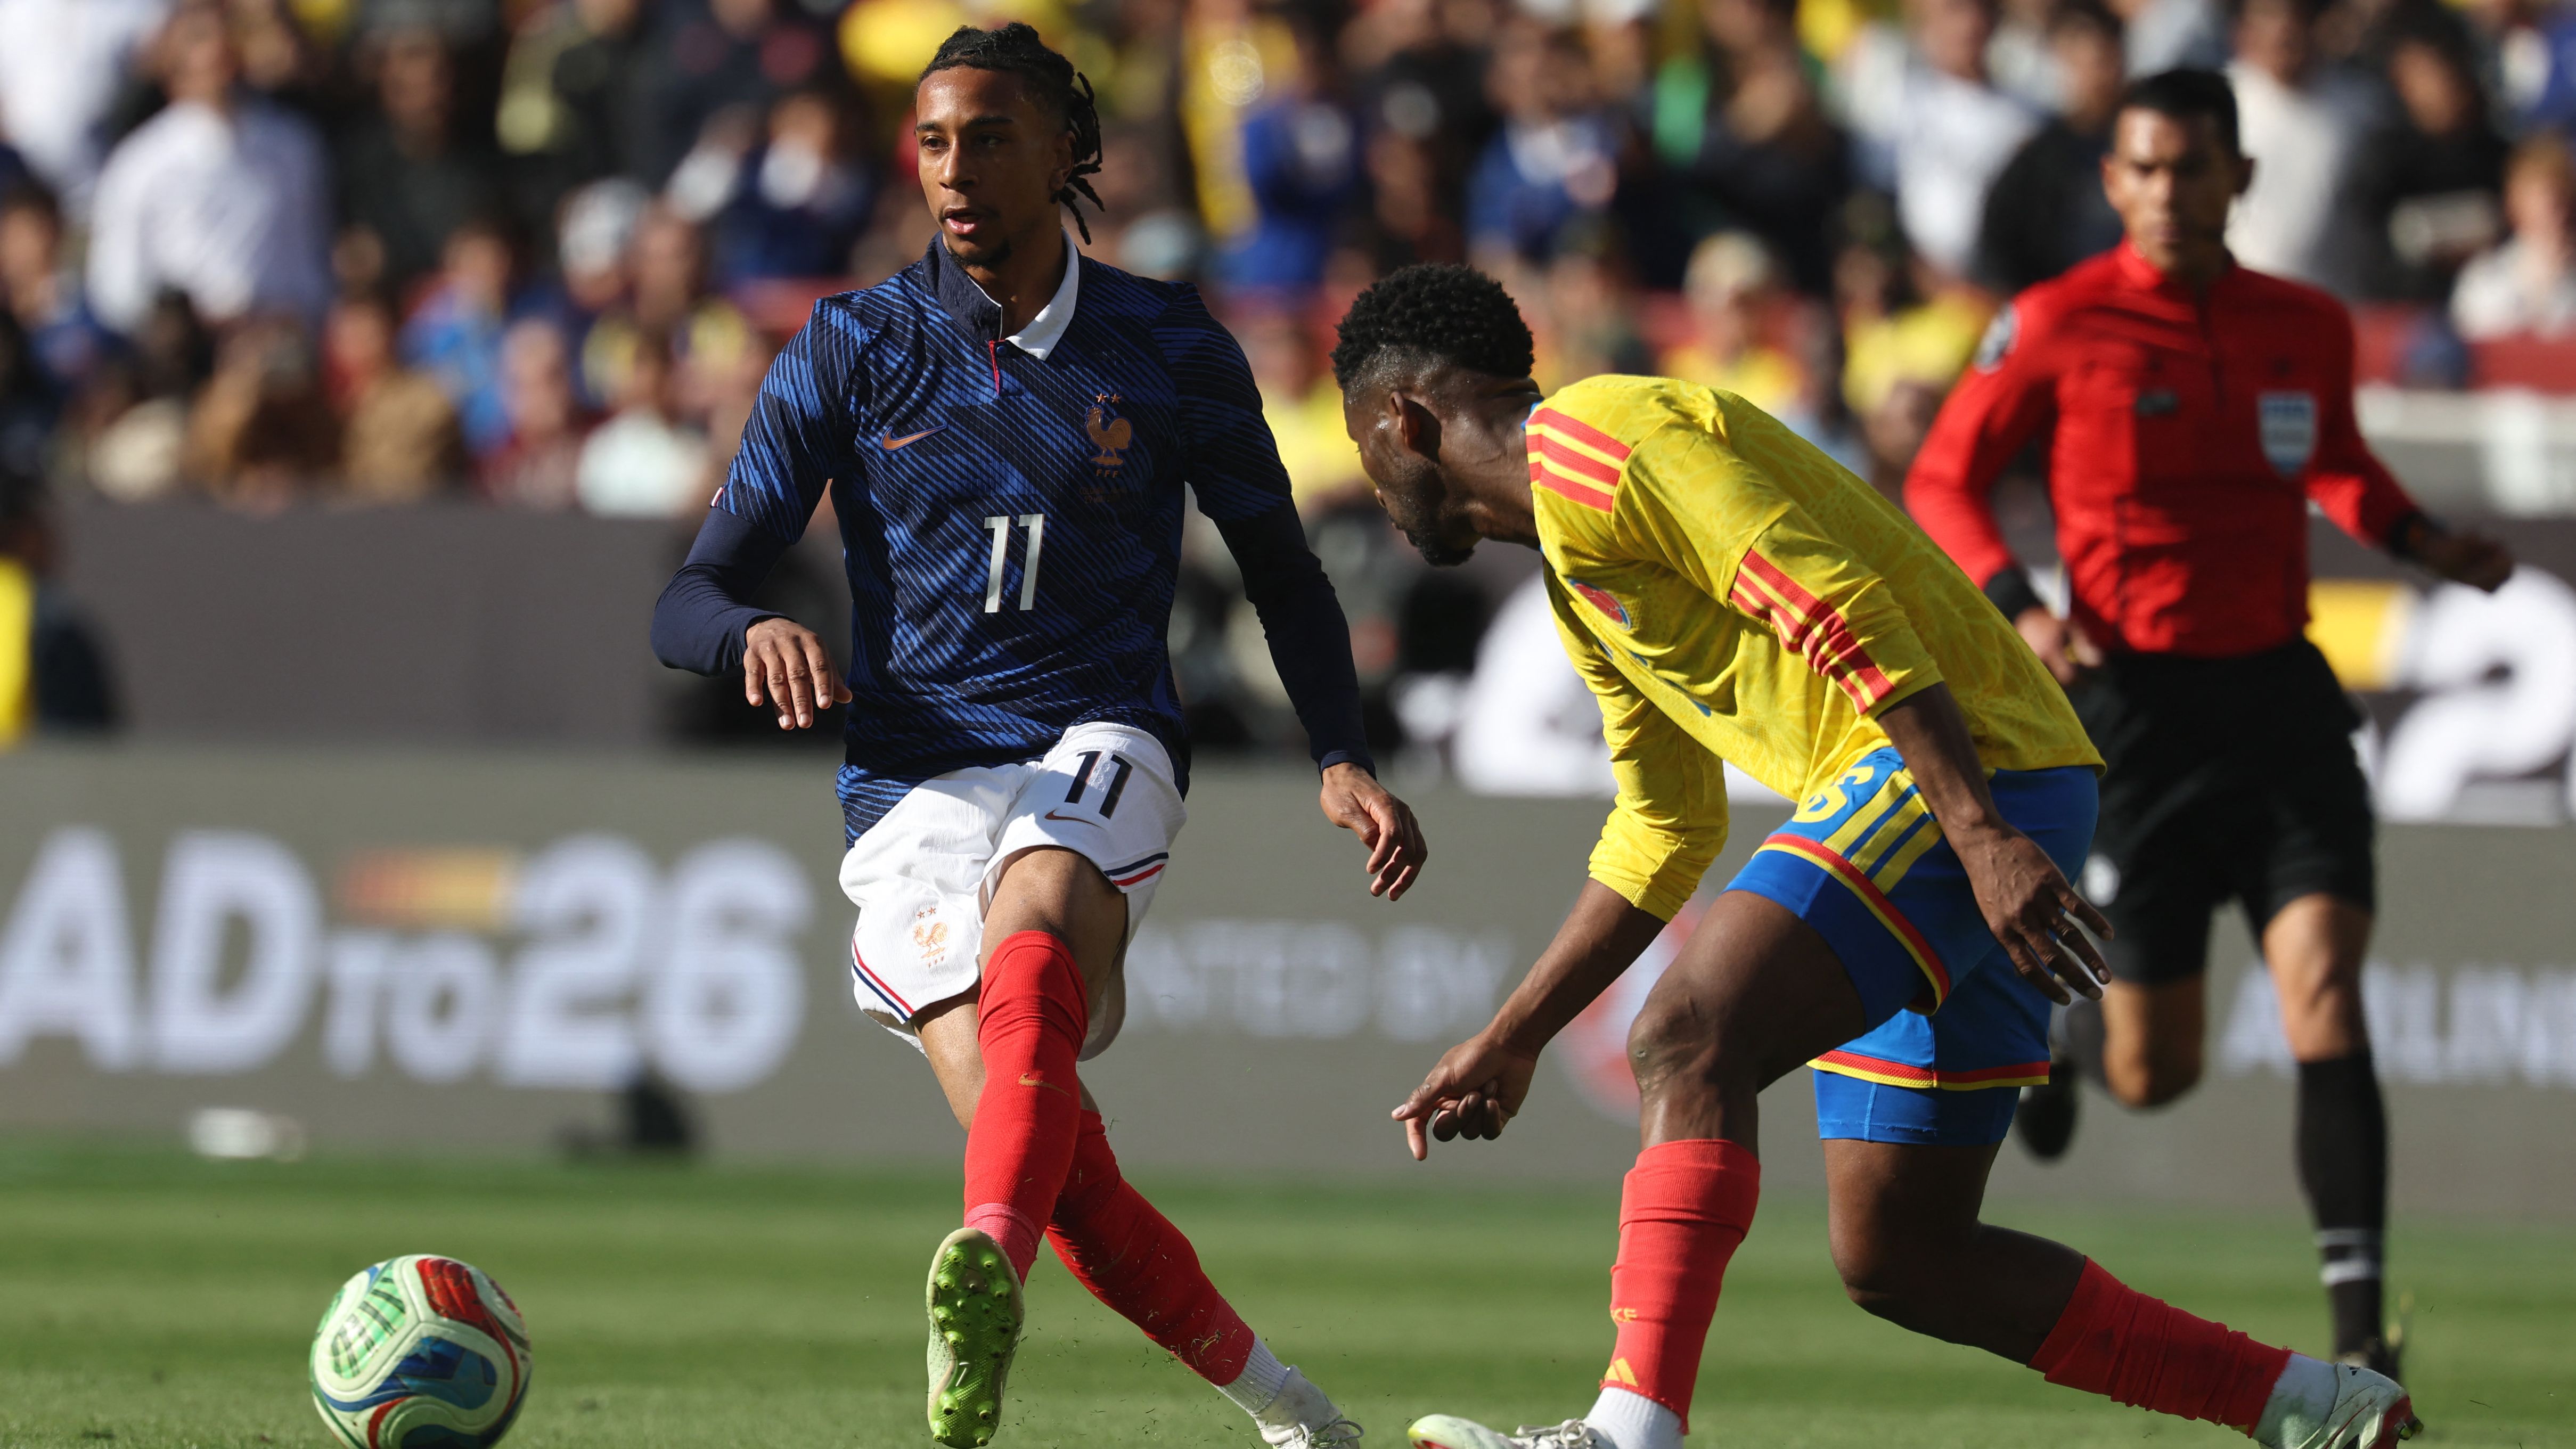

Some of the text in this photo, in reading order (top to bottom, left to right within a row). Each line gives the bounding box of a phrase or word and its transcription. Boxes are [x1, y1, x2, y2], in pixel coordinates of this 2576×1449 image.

[1095, 468, 1119, 479] FFF
[984, 513, 1045, 613] 11
[1064, 750, 1133, 820] 11
